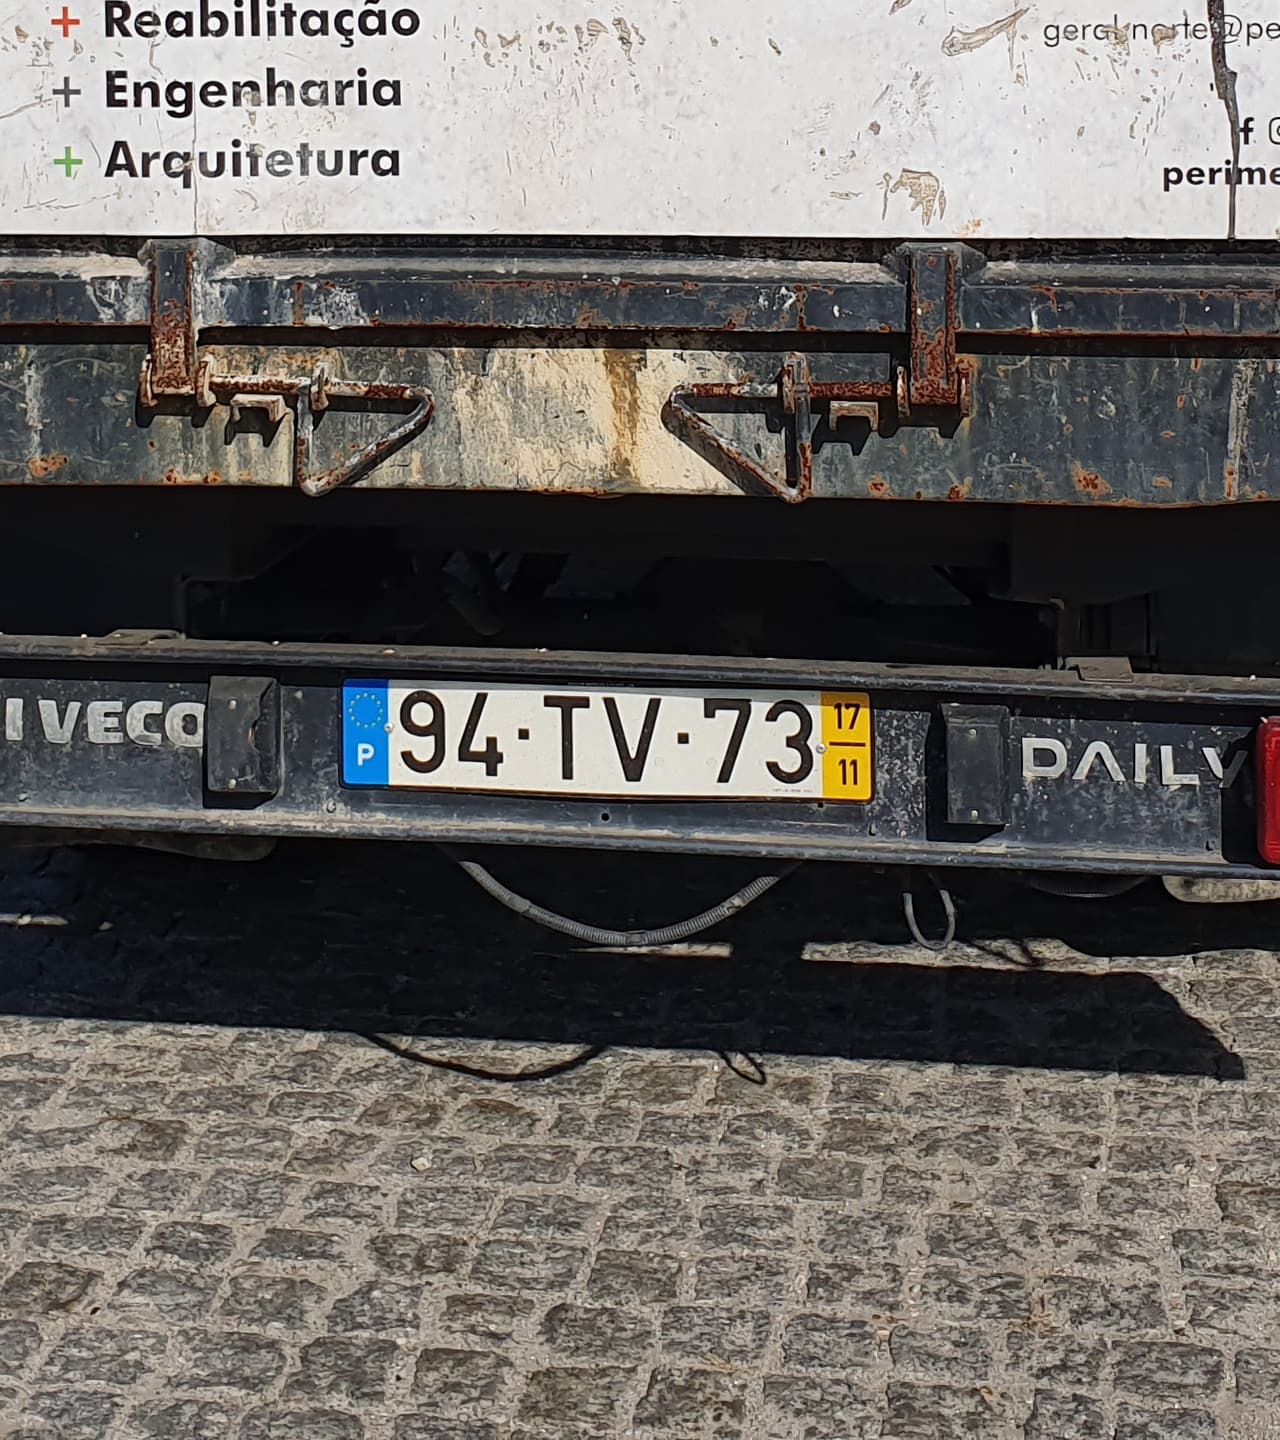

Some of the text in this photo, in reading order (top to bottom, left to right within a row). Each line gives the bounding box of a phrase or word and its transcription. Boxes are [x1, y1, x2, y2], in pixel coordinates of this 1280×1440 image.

[105, 67, 402, 118] Engenharia
[104, 140, 401, 189] Arquitetura
[5, 697, 207, 748] IVECO
[833, 702, 861, 730] 17
[357, 742, 375, 767] P
[838, 758, 859, 786] 11
